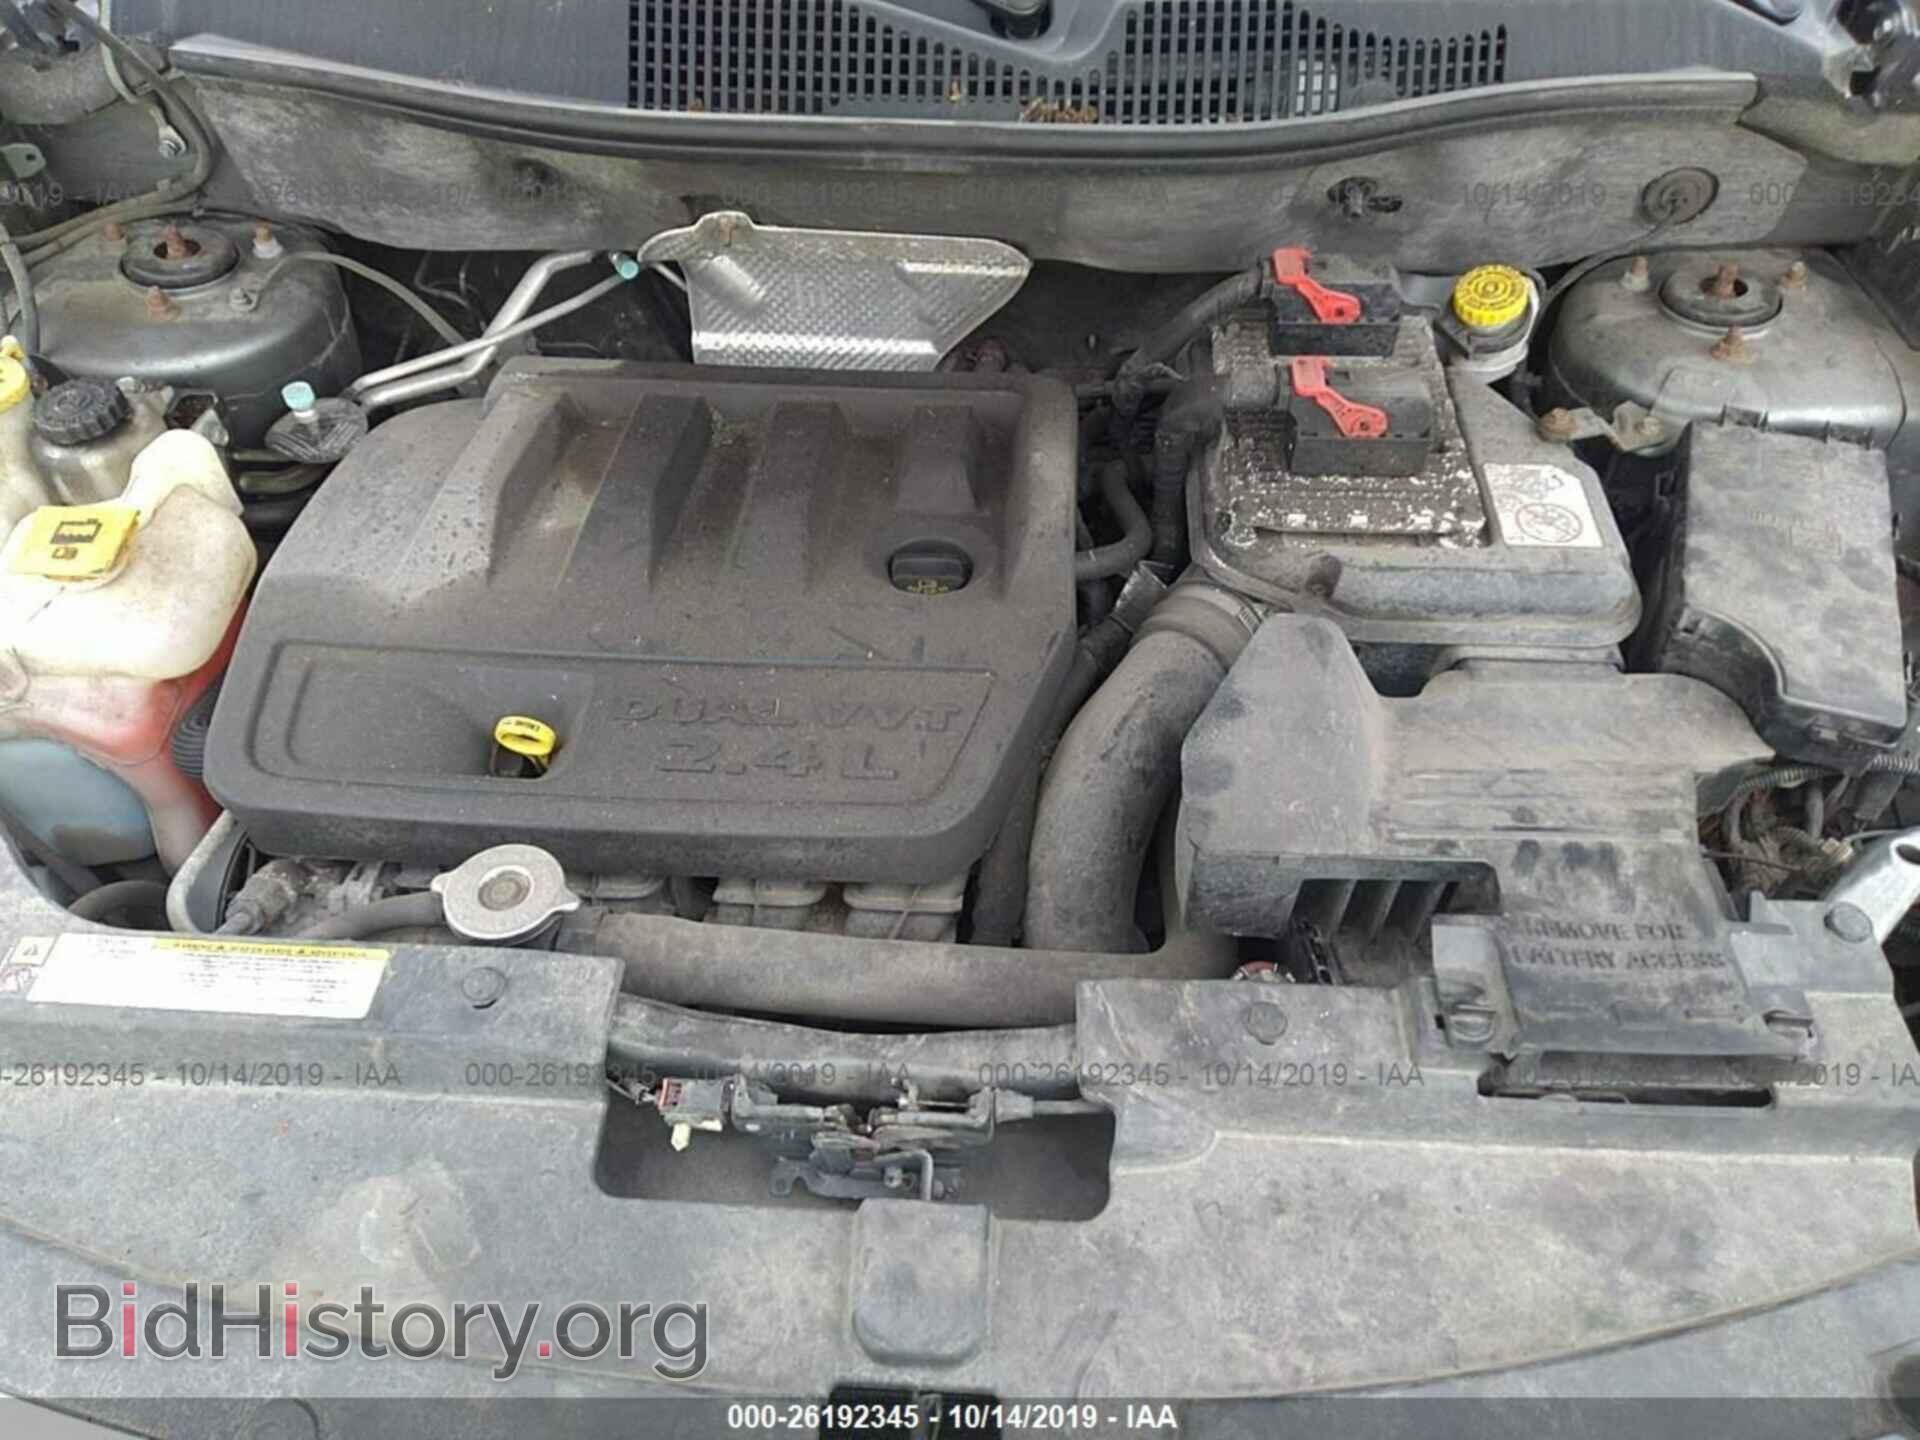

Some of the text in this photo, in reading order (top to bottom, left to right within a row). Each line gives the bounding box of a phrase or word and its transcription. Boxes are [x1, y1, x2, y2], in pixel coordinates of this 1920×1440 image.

[1521, 918, 1688, 942] REMOVE FOR
[1625, 948, 1728, 971] ACCESS
